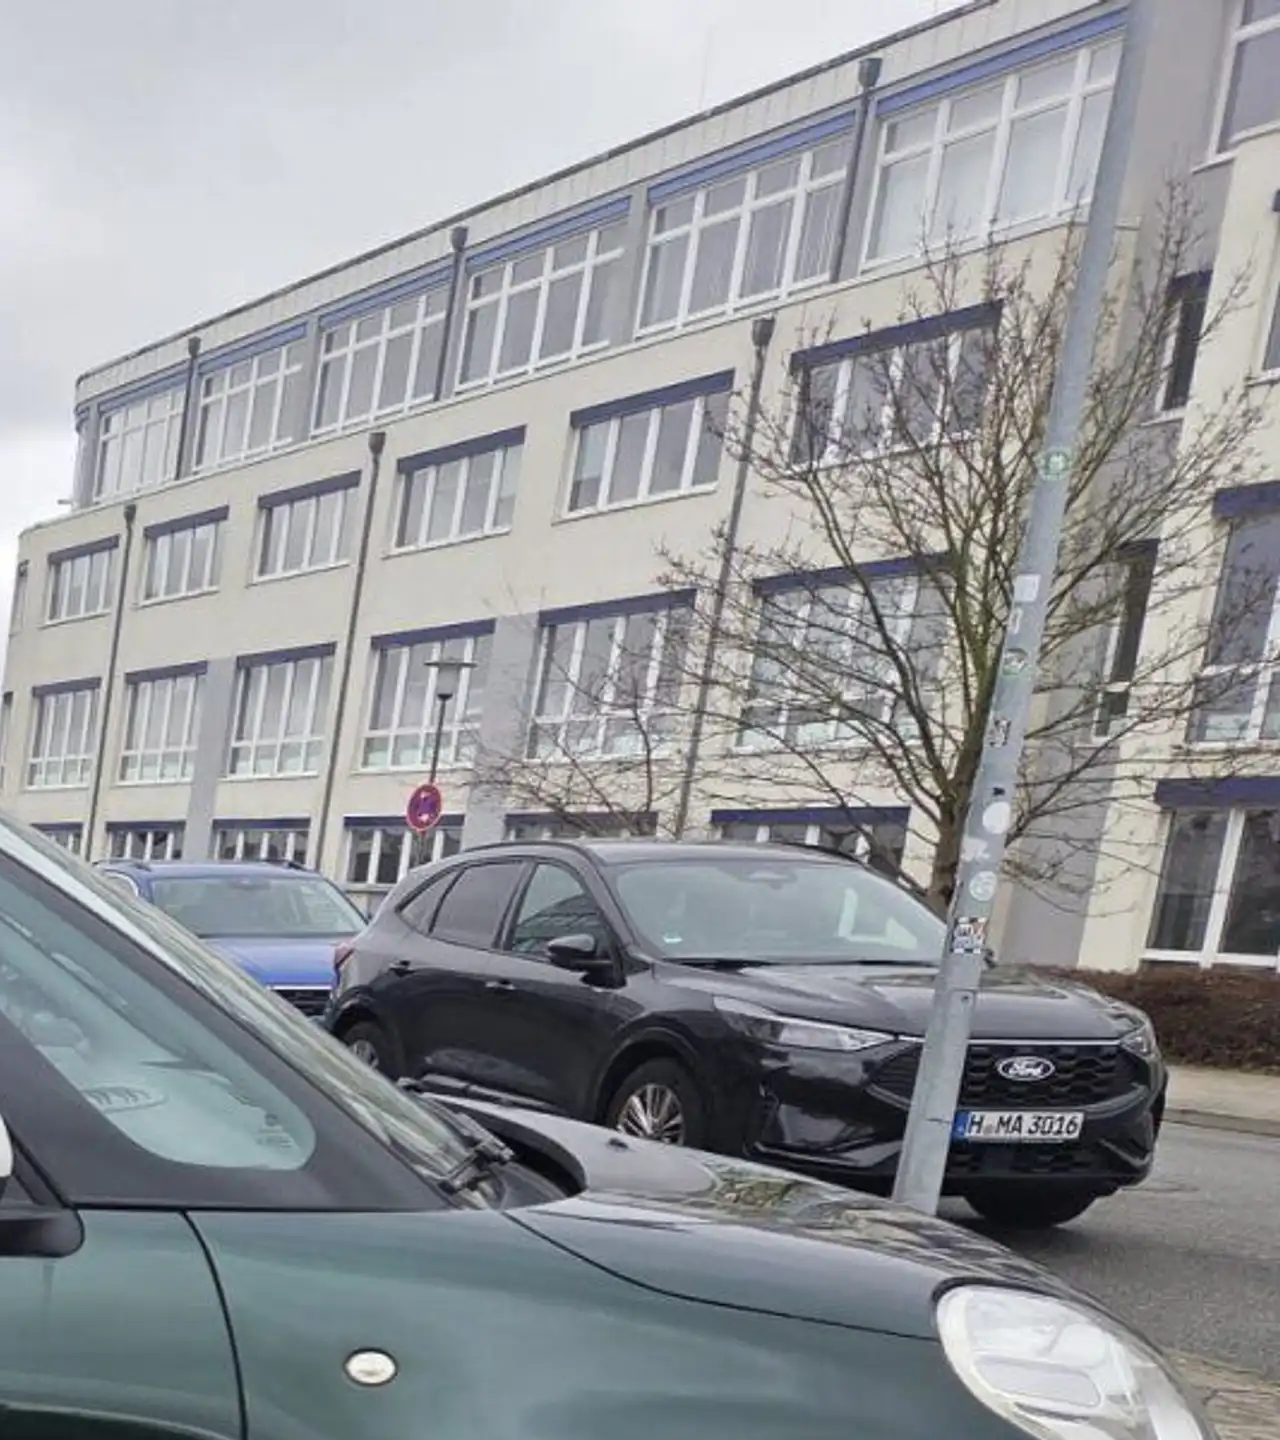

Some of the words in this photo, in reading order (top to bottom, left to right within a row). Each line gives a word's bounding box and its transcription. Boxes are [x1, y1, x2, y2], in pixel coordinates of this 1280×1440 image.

[967, 1114, 985, 1134] H
[995, 1115, 1023, 1134] MA
[1027, 1115, 1080, 1135] 3016
